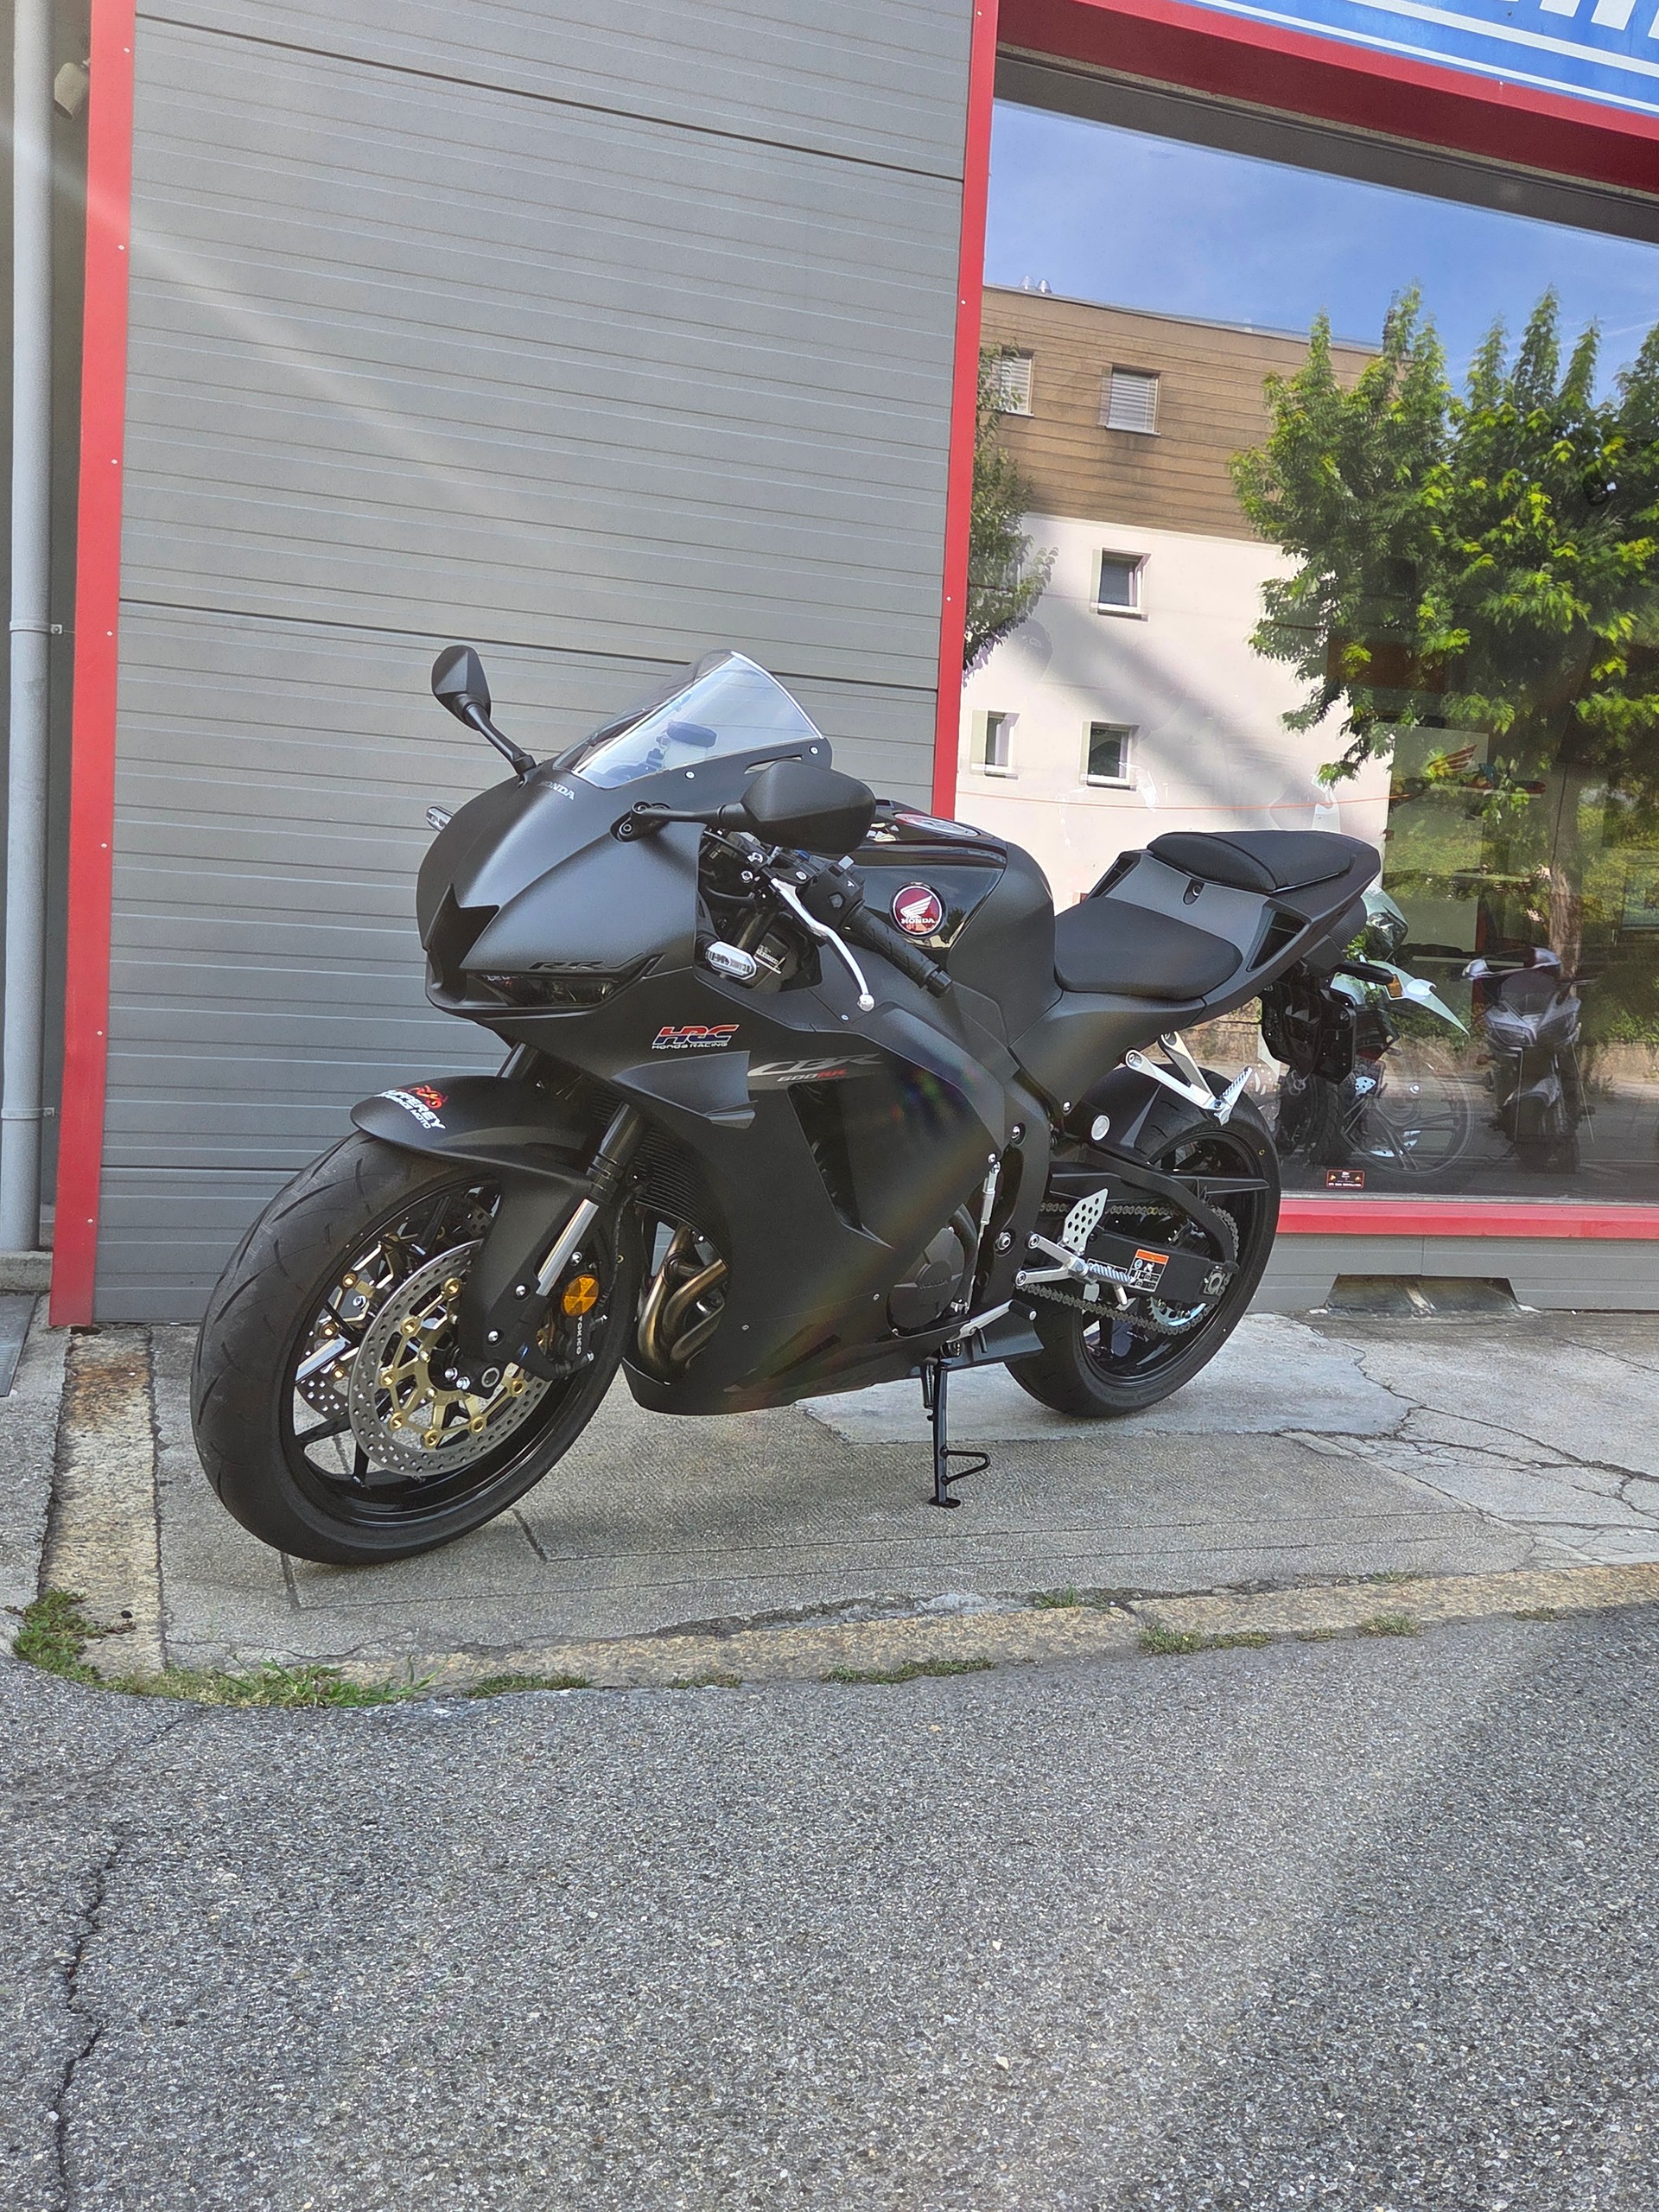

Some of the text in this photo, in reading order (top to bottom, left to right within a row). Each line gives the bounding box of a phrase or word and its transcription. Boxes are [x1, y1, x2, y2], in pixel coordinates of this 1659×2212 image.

[652, 1024, 740, 1046] HRC
[690, 1040, 728, 1049] RACING
[747, 1053, 884, 1077] CBR
[410, 1109, 431, 1129] MOTO
